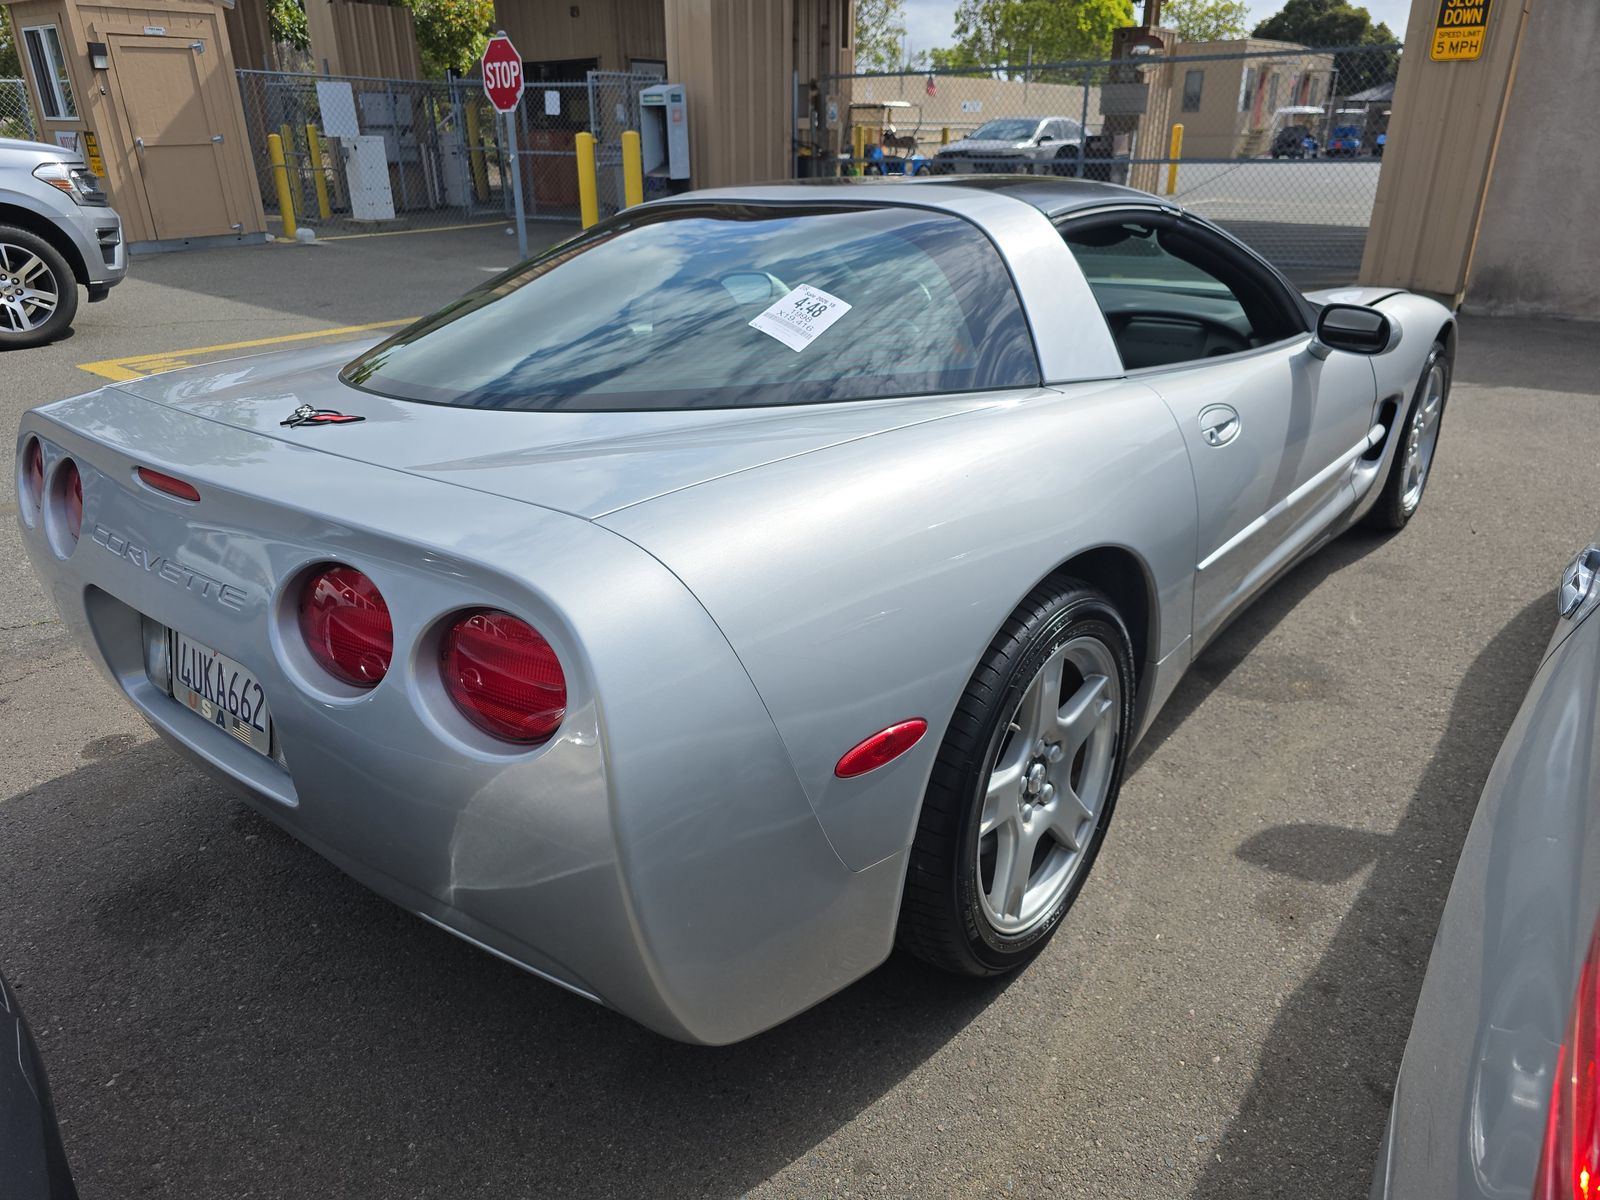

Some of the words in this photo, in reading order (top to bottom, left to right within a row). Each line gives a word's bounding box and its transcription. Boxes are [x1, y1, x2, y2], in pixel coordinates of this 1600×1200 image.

[1443, 8, 1483, 25] DOWN
[1462, 30, 1481, 38] LIMIT
[1436, 42, 1445, 54] 5
[1448, 40, 1479, 54] MPH
[485, 61, 520, 89] STOP
[794, 297, 828, 318] 4:48
[91, 524, 249, 612] CORVETTE
[181, 641, 265, 733] 4UKA662
